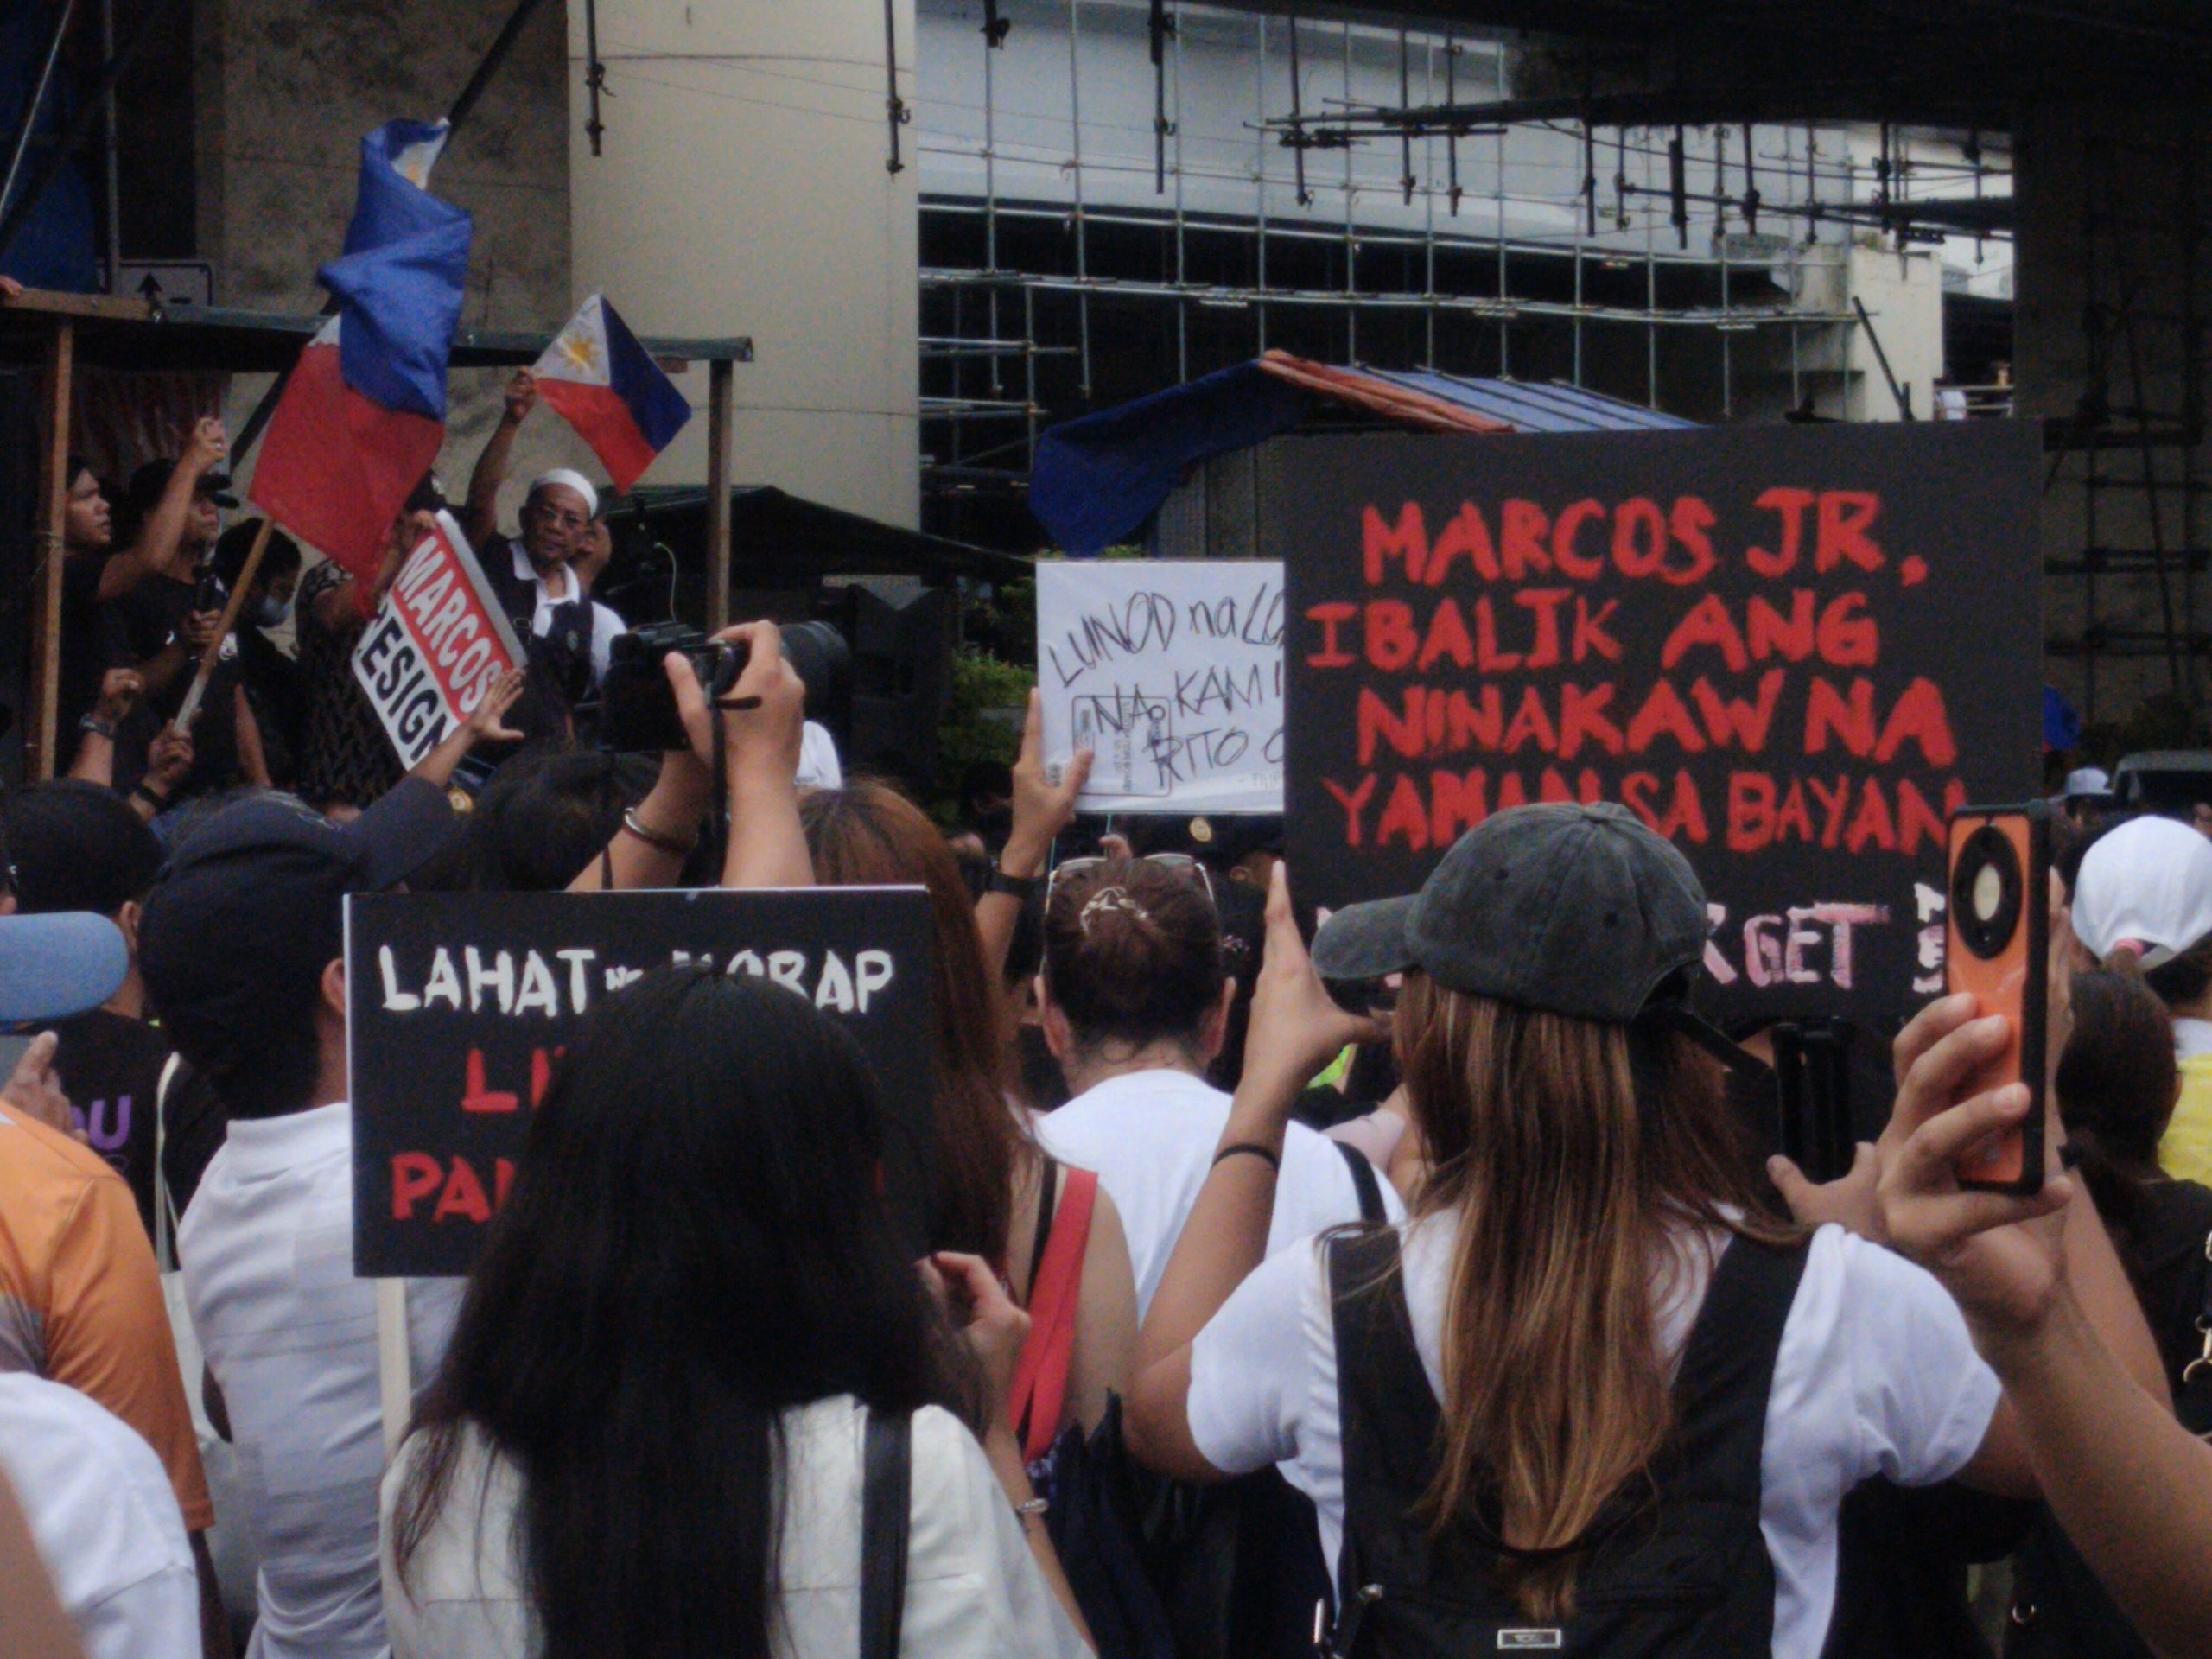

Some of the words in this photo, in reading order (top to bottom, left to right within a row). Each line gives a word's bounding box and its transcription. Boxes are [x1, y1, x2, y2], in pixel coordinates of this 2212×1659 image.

[1362, 496, 1718, 587] MARCOS
[1745, 486, 1929, 588] JR.
[398, 535, 503, 714] MARCOS
[1047, 591, 1176, 688] LUNOD
[1661, 589, 1879, 672] ANG
[359, 603, 448, 762] ESIGN
[1175, 660, 1281, 717] KAMI
[1357, 667, 1785, 766] NINAKAW
[1803, 677, 1955, 767] NA
[1620, 768, 1710, 844] SA
[1727, 772, 1966, 855] BAYAN
[378, 944, 596, 1019] LAHAT
